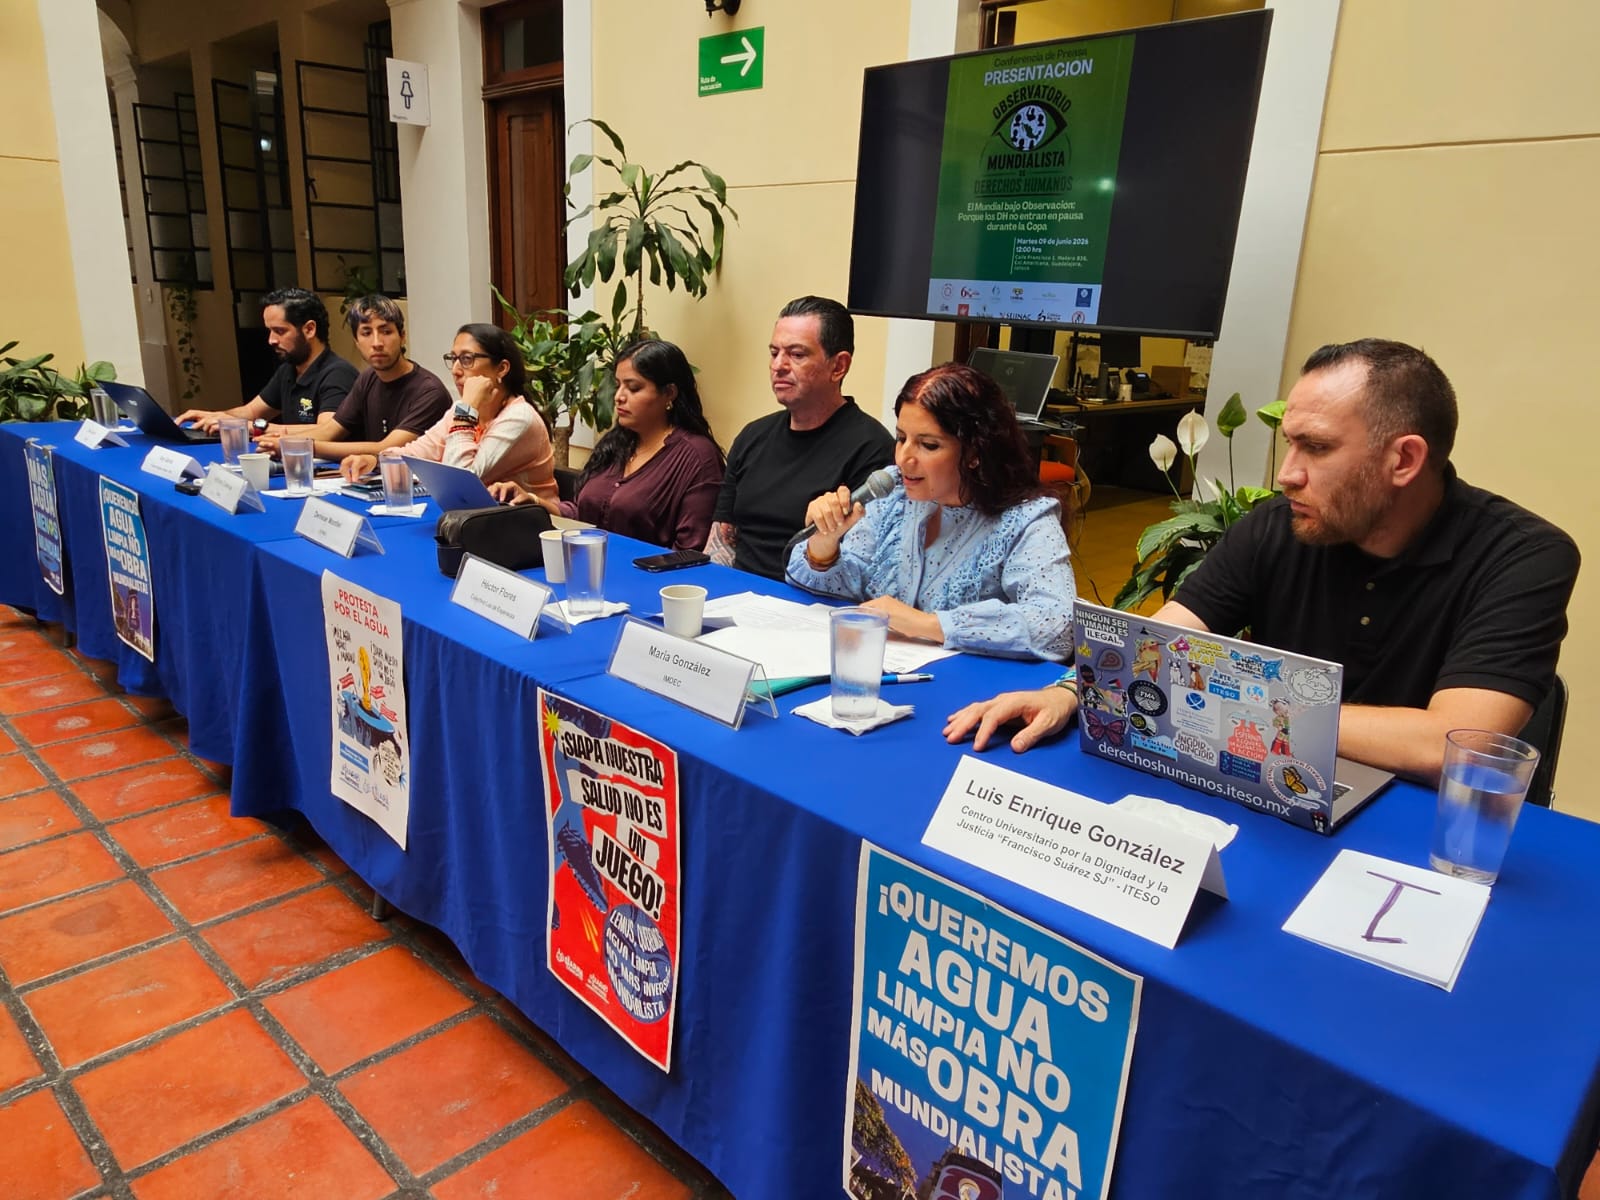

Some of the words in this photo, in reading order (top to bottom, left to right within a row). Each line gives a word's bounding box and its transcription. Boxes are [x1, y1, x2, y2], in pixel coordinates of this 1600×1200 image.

[984, 59, 1093, 86] PRESENTACION
[992, 84, 1072, 119] OBSERVATORIO
[987, 151, 1065, 170] MUNDIALISTA
[974, 179, 1021, 194] DERECHOS
[1024, 176, 1073, 192] HUMANOS
[958, 213, 984, 223] Porque
[985, 212, 995, 221] los
[996, 212, 1008, 221] DH
[1009, 213, 1018, 221] no
[1020, 212, 1047, 221] entran
[1048, 213, 1058, 221] en
[1058, 212, 1083, 222] pausa
[967, 202, 974, 211] El
[975, 201, 1003, 211] Mundial
[1004, 201, 1020, 212] bajo
[987, 222, 1017, 231] durante
[1018, 222, 1025, 231] la
[1026, 222, 1047, 232] Copa
[109, 506, 136, 538] AGUA
[128, 534, 141, 556] NO
[121, 549, 147, 582] OBRA
[338, 588, 379, 618] PROTESTA
[334, 601, 351, 620] POR
[353, 610, 363, 627] EL
[364, 617, 390, 639] AGUA
[1076, 617, 1116, 634] HUMANO
[1118, 627, 1129, 637] ES
[1112, 618, 1129, 629] SER
[649, 645, 670, 662] María
[672, 654, 711, 677] González
[663, 674, 682, 687] IMDEC
[1212, 687, 1235, 698] ITESO
[561, 731, 604, 762] ¡SIAPA
[604, 740, 663, 786] NUESTRA
[1099, 741, 1290, 816] derechoshumanos.iteso.mx
[581, 777, 622, 815] SALUD
[624, 789, 643, 824] NO
[647, 799, 663, 832] ES
[965, 779, 1003, 806] Luis
[1008, 795, 1082, 835] Enrique
[1088, 824, 1185, 875] González
[628, 827, 647, 861] UN
[961, 805, 993, 825] Centro
[995, 815, 1059, 851] Universitario
[1061, 841, 1081, 861] por
[1082, 848, 1092, 864] la
[1093, 856, 1145, 886] Dignidad
[1145, 878, 1155, 890] y
[1157, 879, 1169, 894] la
[595, 834, 663, 920] JUEGO!
[957, 818, 994, 841] Justicia
[1053, 853, 1091, 880] Suárez
[1122, 888, 1161, 907] ITESO
[606, 927, 629, 960] AGUA
[878, 882, 1111, 1023] ¡QUEREMOS
[898, 929, 1053, 1063] AGUA
[877, 970, 988, 1067] LIMPIA
[997, 1034, 1072, 1114] NO
[867, 1007, 927, 1068] MÁS
[927, 1046, 1082, 1191] OBRA
